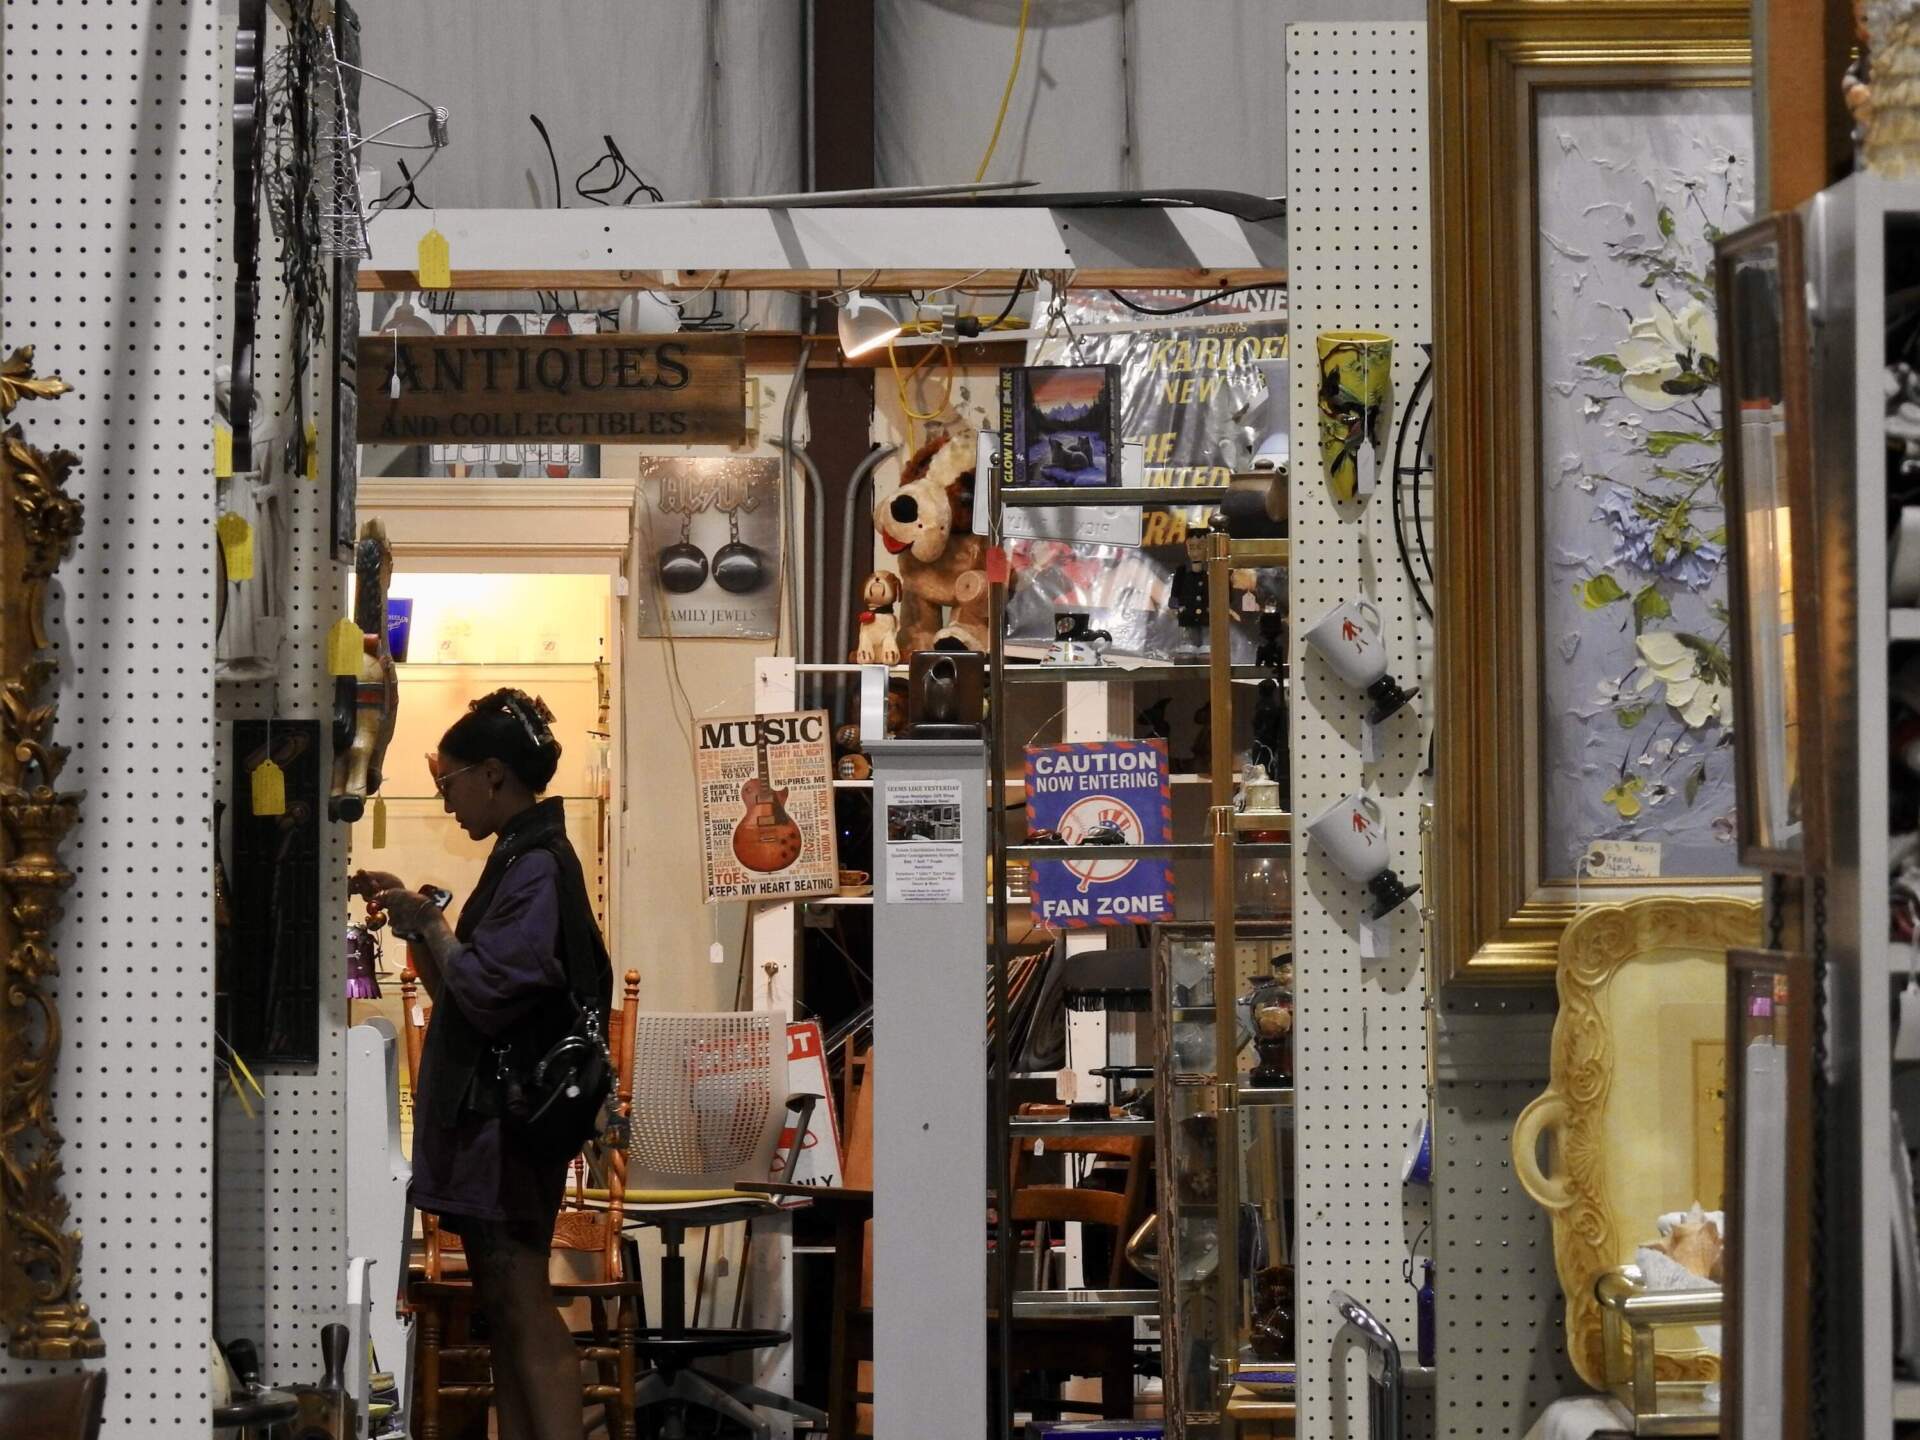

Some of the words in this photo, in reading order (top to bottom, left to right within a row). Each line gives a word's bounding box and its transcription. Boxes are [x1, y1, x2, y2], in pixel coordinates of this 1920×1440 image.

[379, 343, 690, 395] ANTIQUES
[1163, 375, 1227, 404] NEW
[380, 414, 438, 436] AND
[449, 410, 688, 436] COLLECTIBLES
[1003, 406, 1014, 429] THE
[1003, 432, 1014, 447] IN
[1003, 448, 1014, 483] GLOW
[709, 609, 759, 625] JEWELS
[699, 716, 823, 750] MUSIC
[1035, 751, 1157, 775] CAUTION
[774, 777, 811, 786] INSPIRES
[813, 775, 827, 783] ME
[1036, 775, 1074, 793] NOW
[1079, 771, 1159, 791] ENTERING
[793, 811, 814, 820] THE
[820, 819, 830, 832] MY
[712, 823, 734, 831] SOUL
[821, 833, 832, 862] WORLD
[708, 885, 738, 897] KEEPS
[742, 885, 757, 895] MY
[760, 881, 791, 894] HEART
[795, 878, 833, 891] BEATING
[715, 872, 750, 885] TOES
[1042, 898, 1089, 917] FAN
[1096, 894, 1165, 915] ZONE
